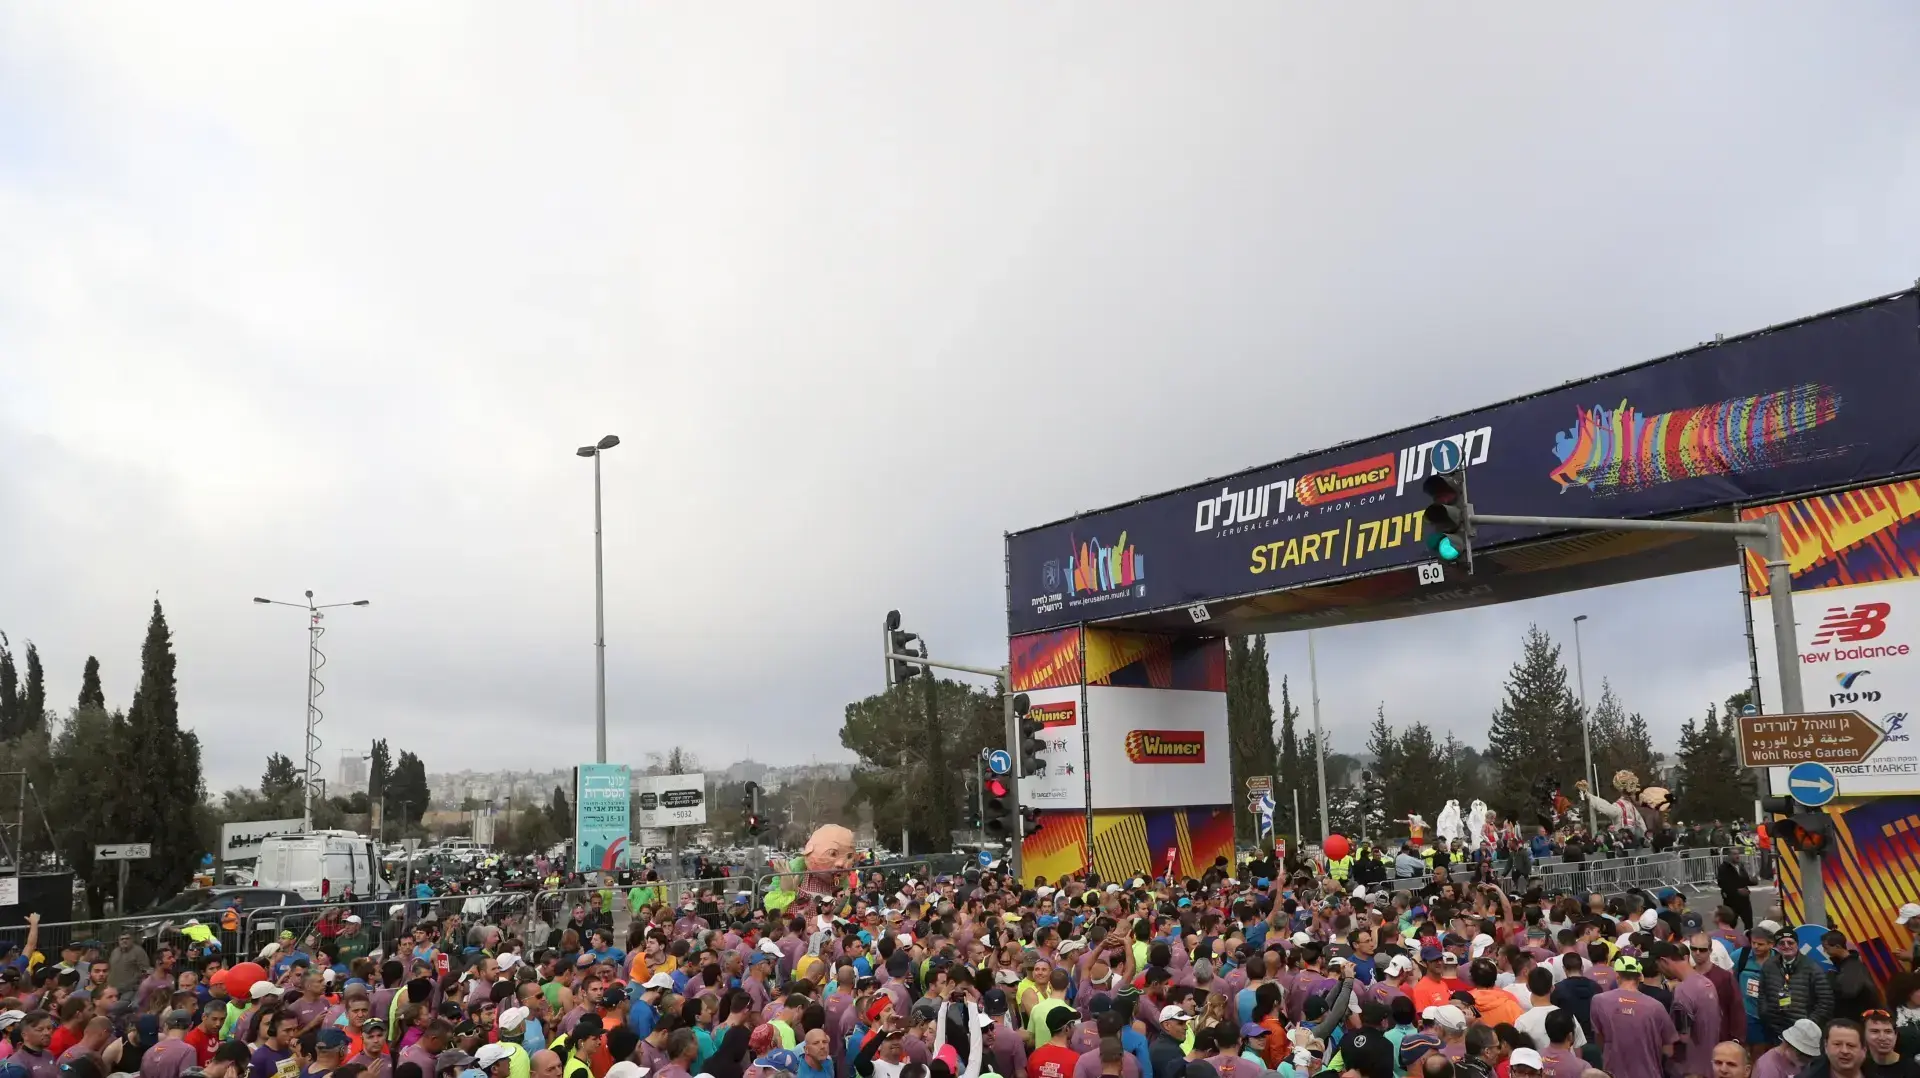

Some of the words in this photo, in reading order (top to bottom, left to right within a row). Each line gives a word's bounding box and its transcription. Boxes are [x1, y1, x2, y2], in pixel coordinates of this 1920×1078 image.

[1315, 466, 1390, 494] Winner
[1195, 478, 1296, 532] ירושלים
[1250, 529, 1340, 574] START
[1422, 567, 1440, 580] 6.0
[1037, 602, 1063, 614] בירושלים
[1193, 609, 1205, 619] 6.0
[1798, 650, 1830, 664] new
[1834, 644, 1910, 662] balance
[1829, 692, 1860, 708] עדן
[1031, 708, 1073, 723] Winner
[1753, 718, 1797, 733] לוורדים
[1802, 718, 1836, 731] וואהל
[1840, 719, 1850, 731] גן
[1143, 736, 1201, 755] Winner
[1820, 733, 1854, 745] حديقة
[1752, 750, 1780, 760] Wohl
[1783, 749, 1812, 759] Rose
[1815, 748, 1859, 758] Garden
[1829, 765, 1871, 774] TARGET
[1873, 763, 1918, 773] MARKET
